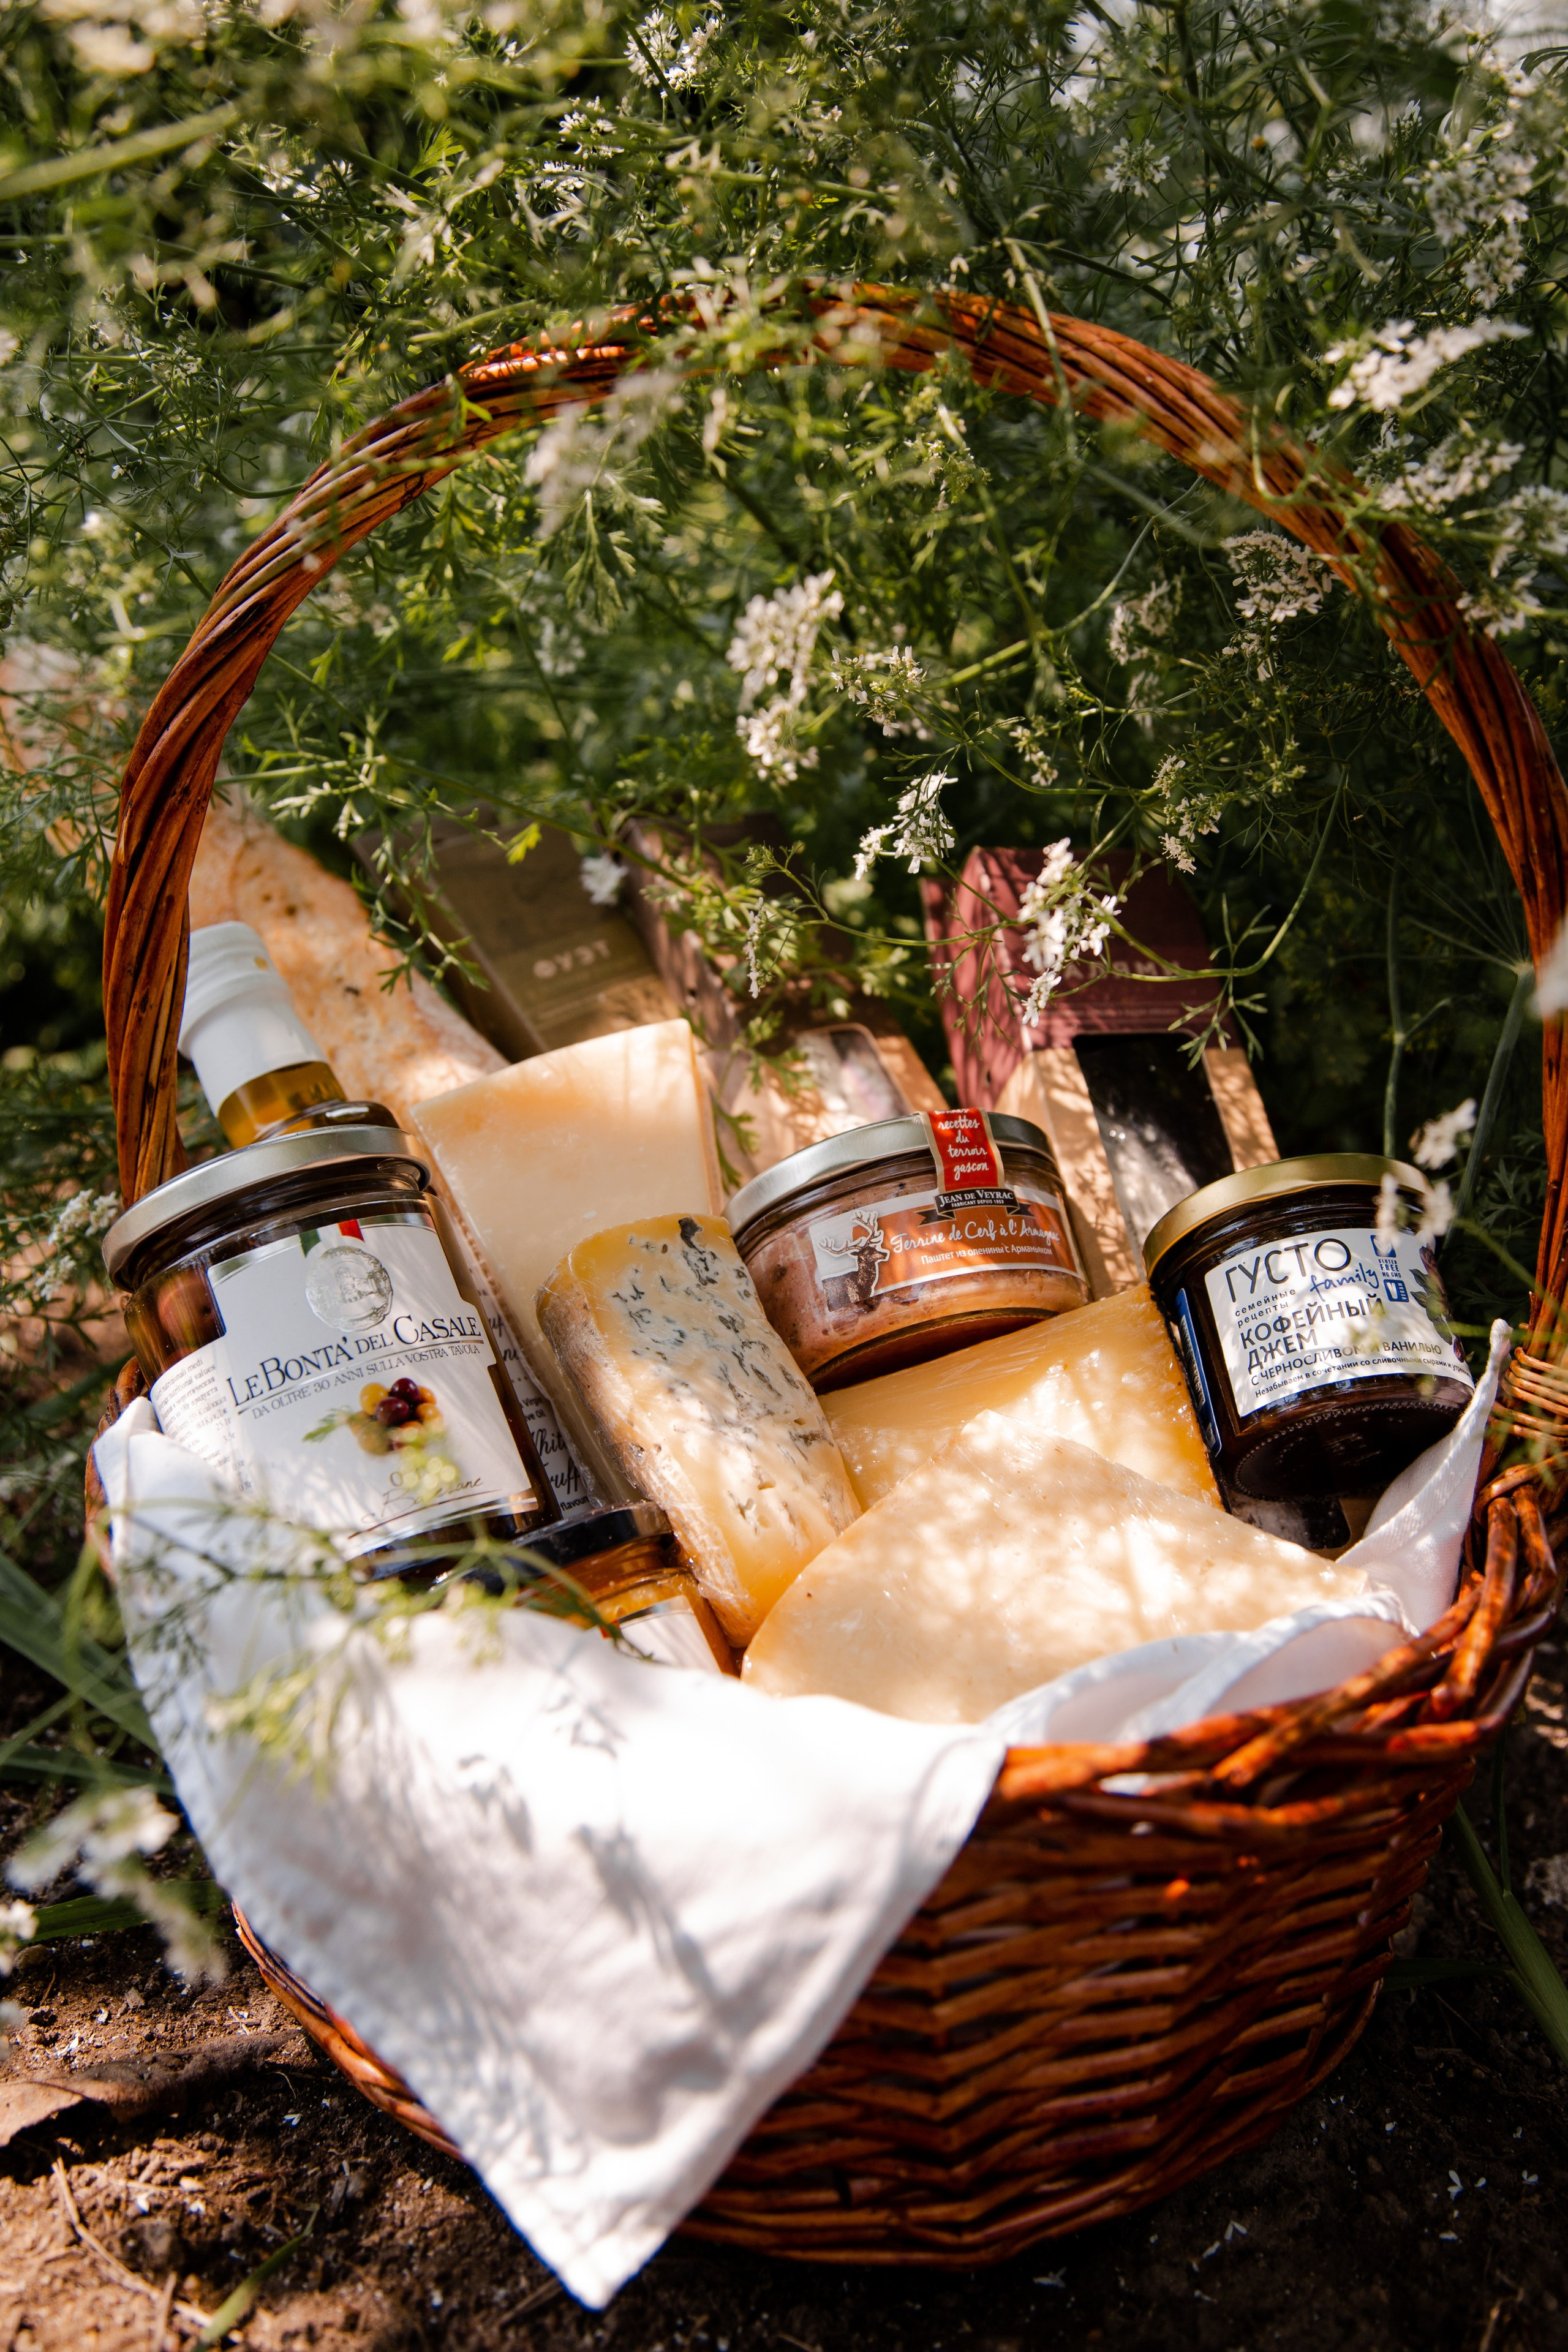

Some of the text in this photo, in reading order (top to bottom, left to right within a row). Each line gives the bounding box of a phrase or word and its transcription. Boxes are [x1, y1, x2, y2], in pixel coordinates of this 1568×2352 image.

[1064, 960, 1181, 979] АЛЯМИ
[938, 1115, 980, 1129] recettes
[956, 1129, 970, 1144] du
[948, 1144, 987, 1158] terroir
[954, 1162, 989, 1181] gascon
[938, 1194, 963, 1207] JEAN
[976, 1190, 1014, 1199] VEYRAC
[889, 1232, 946, 1253] Terrine
[949, 1224, 963, 1241] de
[965, 1219, 997, 1241] Cerf
[1000, 1224, 1008, 1236] à
[921, 1251, 954, 1265] Паштет
[968, 1246, 1004, 1256] оленины
[1011, 1244, 1053, 1255] Арманьяком
[1225, 1238, 1351, 1303] ГУСТО
[1310, 1262, 1379, 1302] family
[1397, 1283, 1407, 1300] VEGAN
[1235, 1289, 1296, 1317] семейные
[1237, 1302, 1289, 1329] рецепты
[1240, 1293, 1386, 1349] КОФЕЙНЫЙ
[354, 1334, 393, 1355] DEL
[393, 1315, 481, 1345] CASALE
[1247, 1329, 1317, 1375] ДЖЕМ
[187, 1357, 203, 1372] medi
[194, 1364, 216, 1379] values
[1251, 1375, 1259, 1386] С
[1261, 1344, 1365, 1380] ЧЕРНОСЛИВОМ
[1382, 1341, 1441, 1355] ВАНИЛЬЮ
[252, 1344, 480, 1419] DA OLTRE 30 ANNI SULLA VOSTRA TAVOLA
[1255, 1374, 1304, 1398] Незабываем
[1312, 1361, 1358, 1377] сочетании
[1423, 1358, 1447, 1366] сырами
[191, 1387, 218, 1406] продукта
[522, 1398, 543, 1407] Virgin
[535, 1409, 546, 1418] Oil
[560, 1496, 590, 1512] flavour
